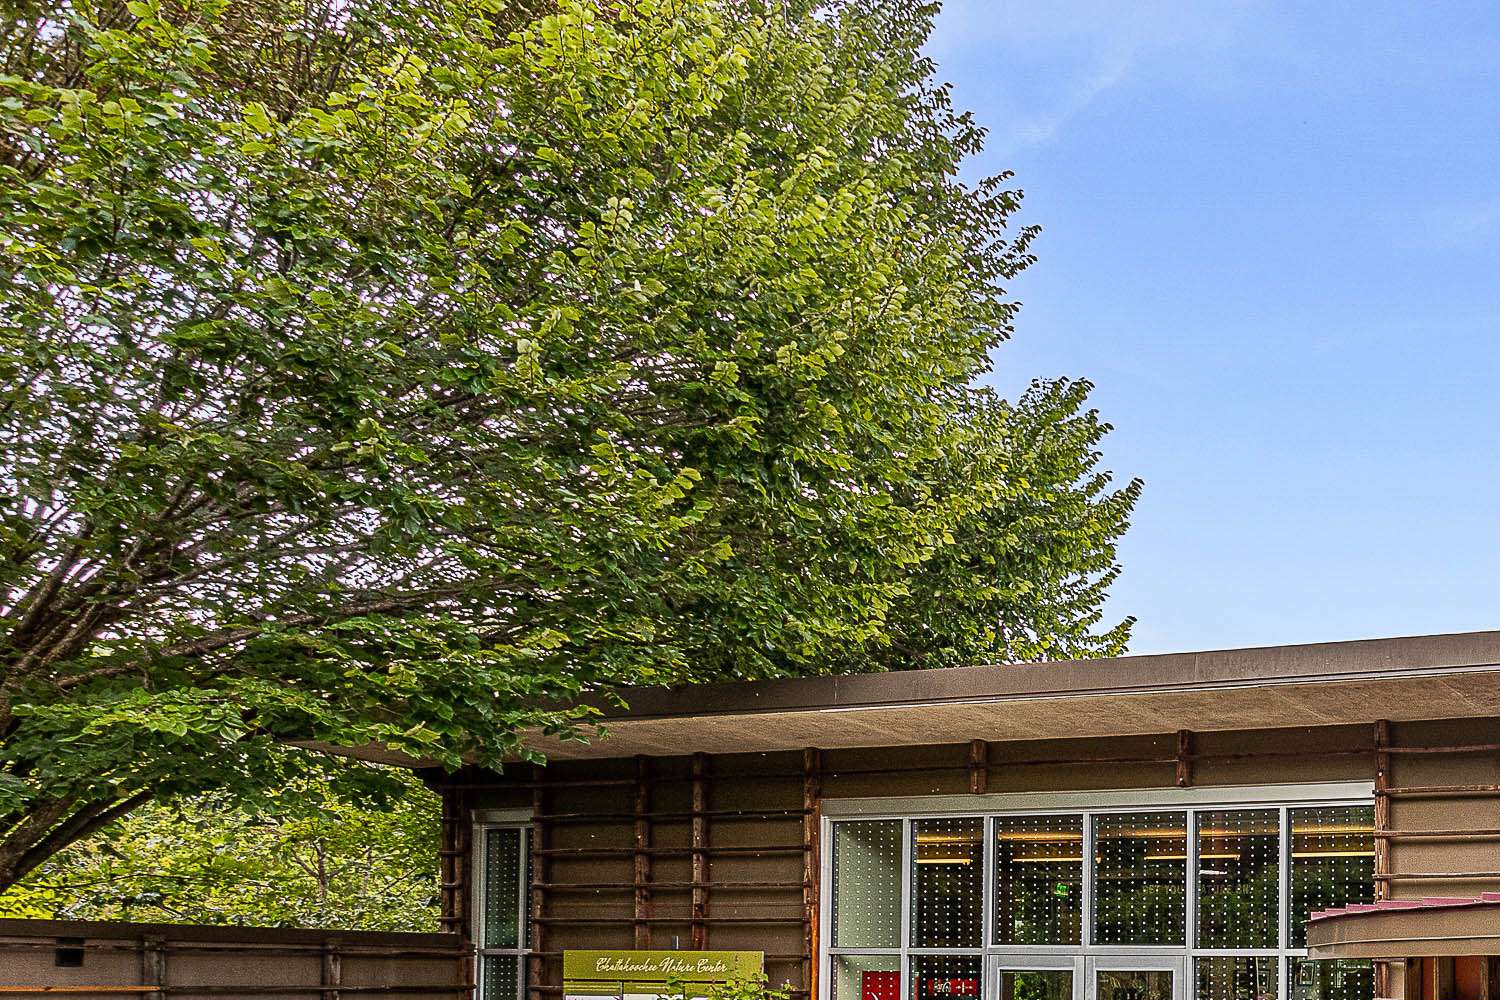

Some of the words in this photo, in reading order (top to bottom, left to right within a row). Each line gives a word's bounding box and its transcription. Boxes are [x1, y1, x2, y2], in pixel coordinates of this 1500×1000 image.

[596, 957, 658, 973] Chattahoochee
[659, 956, 694, 973] Nature
[696, 958, 728, 973] Center
